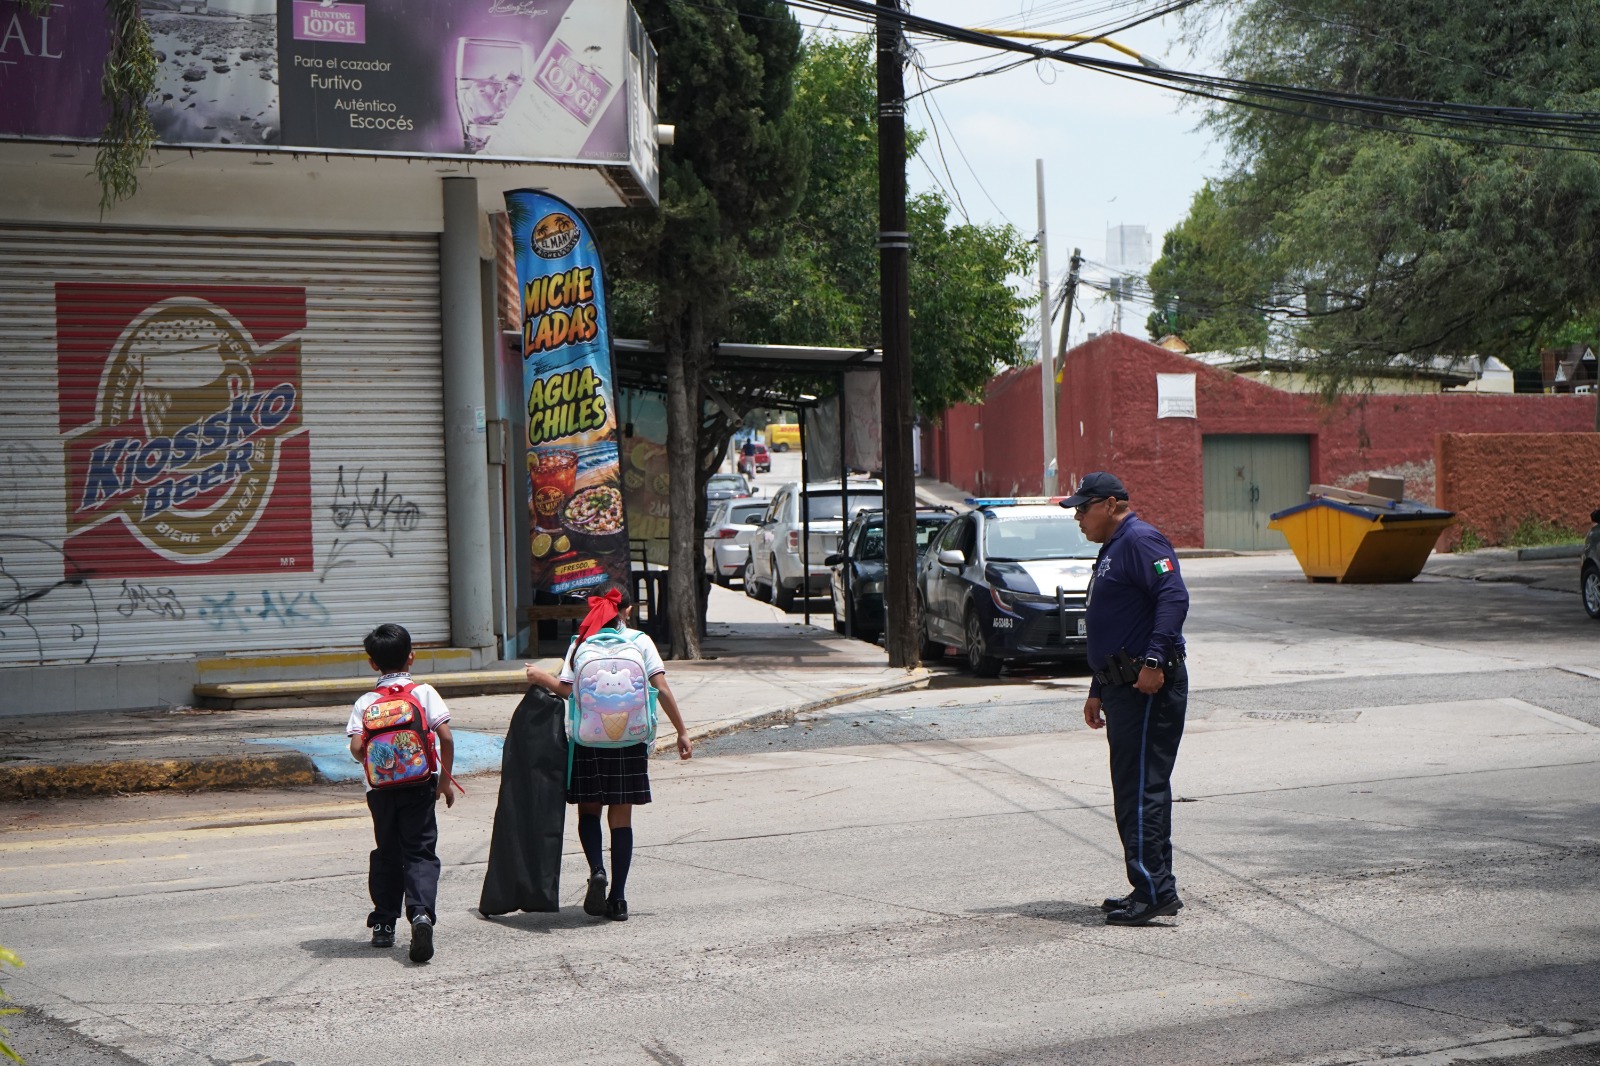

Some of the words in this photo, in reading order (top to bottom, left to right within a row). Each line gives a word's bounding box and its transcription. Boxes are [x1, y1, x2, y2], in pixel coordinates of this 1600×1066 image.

[310, 9, 351, 19] HUNTING
[303, 16, 356, 36] LODGE
[294, 55, 323, 68] Para
[326, 57, 337, 69] el
[340, 59, 392, 72] cazador
[310, 74, 363, 91] Furtivo
[334, 98, 397, 112] Auténtico
[349, 113, 414, 131] Escocés
[541, 240, 550, 249] EL
[523, 266, 594, 318] MICHE
[524, 304, 598, 358] LADAS
[529, 395, 606, 445] CHILES
[140, 440, 254, 522] BEER
[211, 477, 259, 537] CERVEZA
[155, 522, 200, 543] BIERE
[280, 557, 296, 567] MR
[555, 582, 570, 592] BIEN
